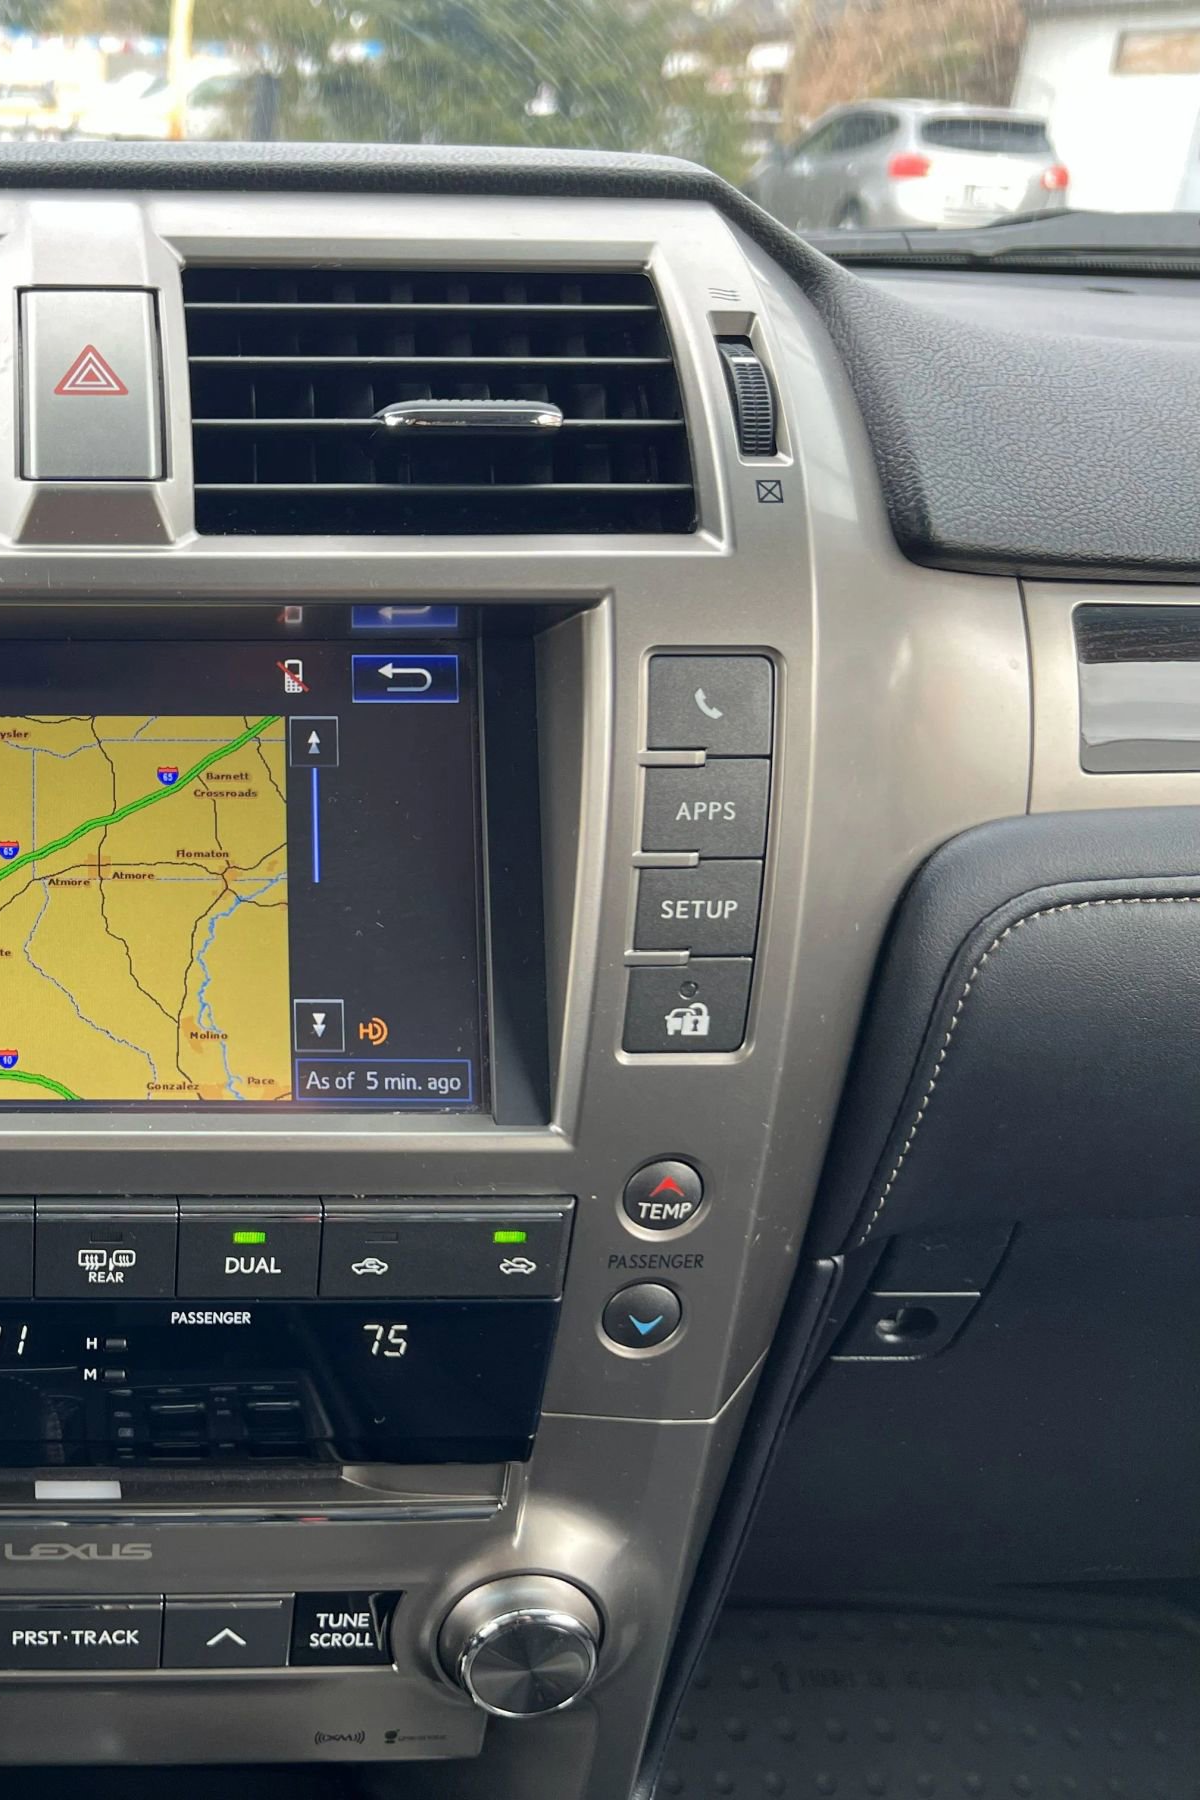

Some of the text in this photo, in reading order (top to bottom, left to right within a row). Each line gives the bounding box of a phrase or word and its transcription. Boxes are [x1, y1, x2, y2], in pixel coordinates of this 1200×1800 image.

[162, 772, 174, 782] 65
[206, 771, 250, 781] Barnett
[193, 788, 258, 799] Crossroads
[675, 801, 736, 821] APPS
[3, 846, 15, 857] 65
[48, 877, 91, 887] Atmore
[112, 871, 155, 881] Atmore
[660, 900, 738, 919] SETUP
[190, 1031, 229, 1041] Molino
[3, 1055, 13, 1066] 10
[146, 1081, 199, 1091] Gonzalez
[247, 1076, 275, 1086] Pace
[306, 1070, 462, 1096] As of 5 min. ago
[637, 1201, 692, 1220] TEMP
[224, 1256, 282, 1275] DUAL
[607, 1253, 704, 1270] PASSENGER
[88, 1271, 125, 1284] REAR
[170, 1311, 252, 1326] PASSENGER
[86, 1337, 98, 1351] H
[363, 1323, 409, 1358] 75
[83, 1368, 98, 1381] M
[4, 1542, 153, 1561] LEXUS
[316, 1612, 370, 1629] TUNE
[309, 1631, 374, 1648] SCROLL
